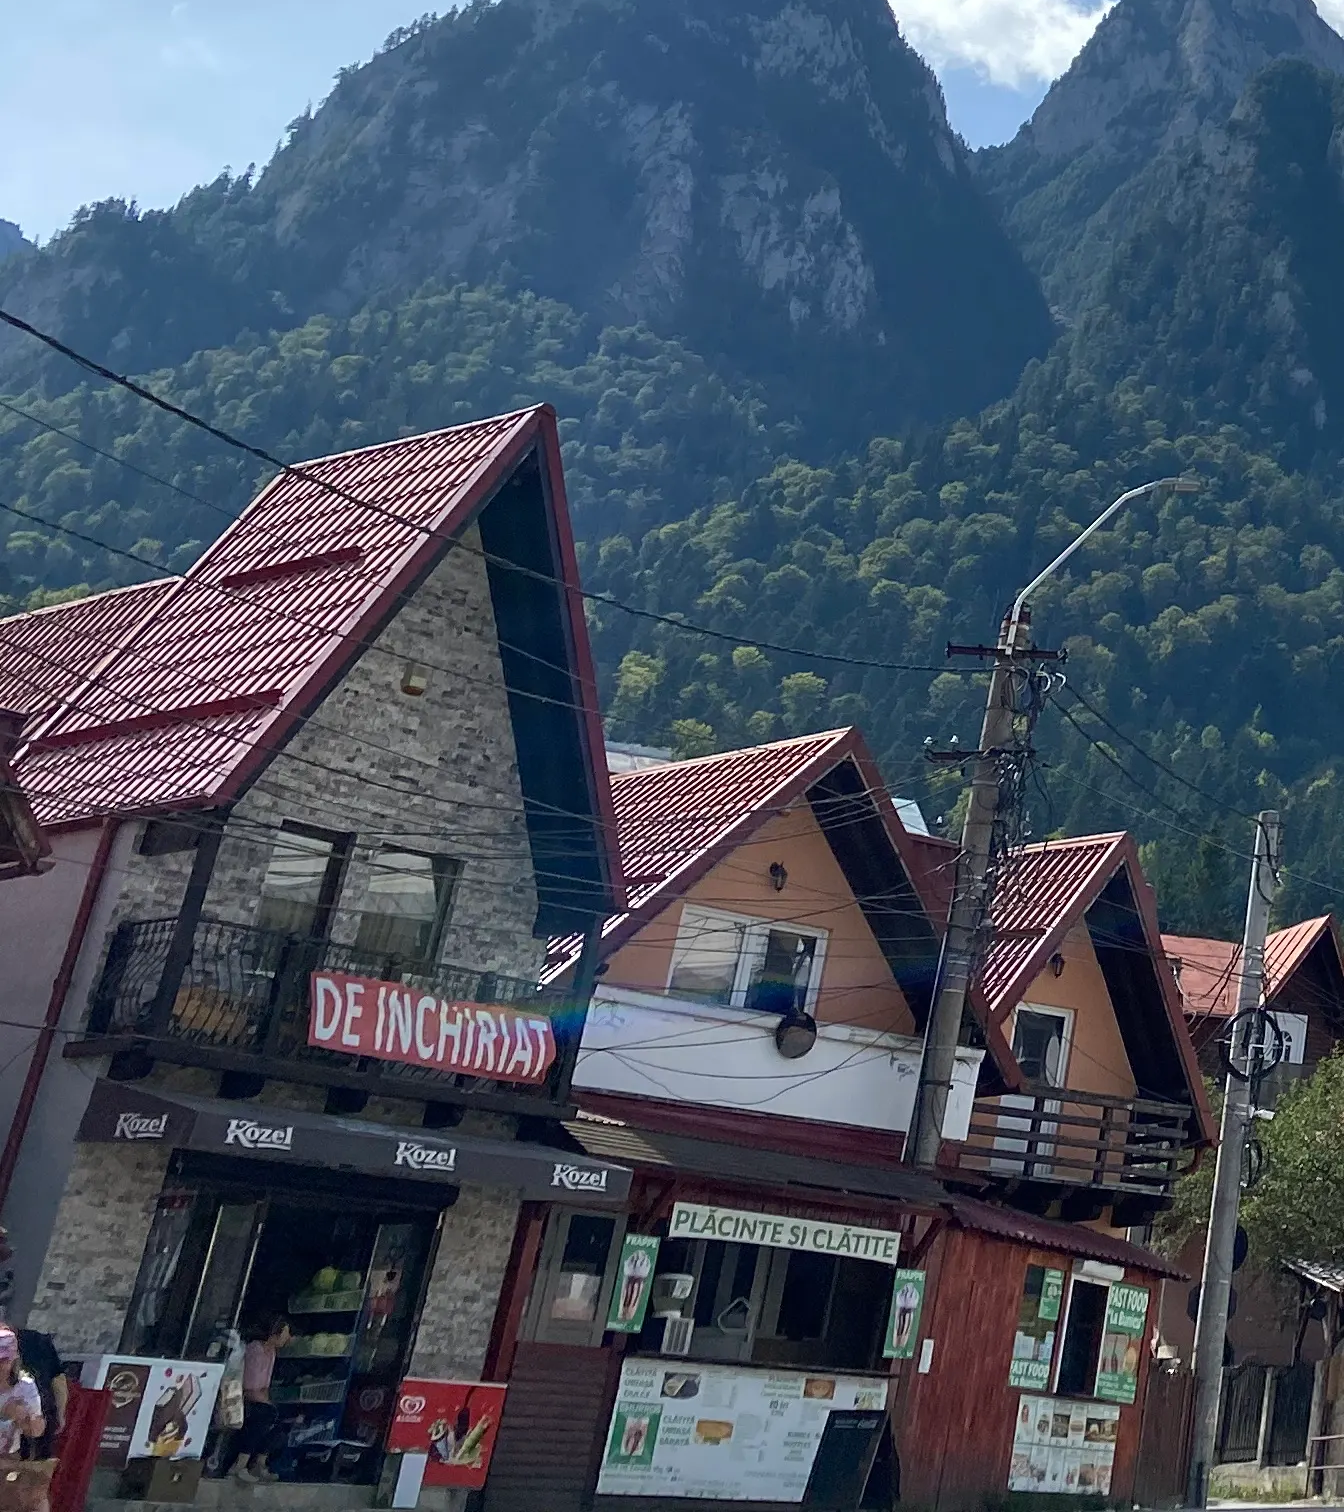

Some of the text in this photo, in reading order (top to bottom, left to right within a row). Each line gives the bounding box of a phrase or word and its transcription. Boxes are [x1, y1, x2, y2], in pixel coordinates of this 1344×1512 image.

[315, 977, 549, 1078] DE INCHIRIAT
[114, 1112, 170, 1138] Kozel
[224, 1119, 295, 1151] Kozel
[393, 1142, 457, 1171] Kozel
[550, 1163, 609, 1192] Kozel
[673, 1206, 785, 1244] PLĂCINTE
[812, 1228, 897, 1259] CLĂTITE
[1109, 1285, 1149, 1313] FAST FOOD
